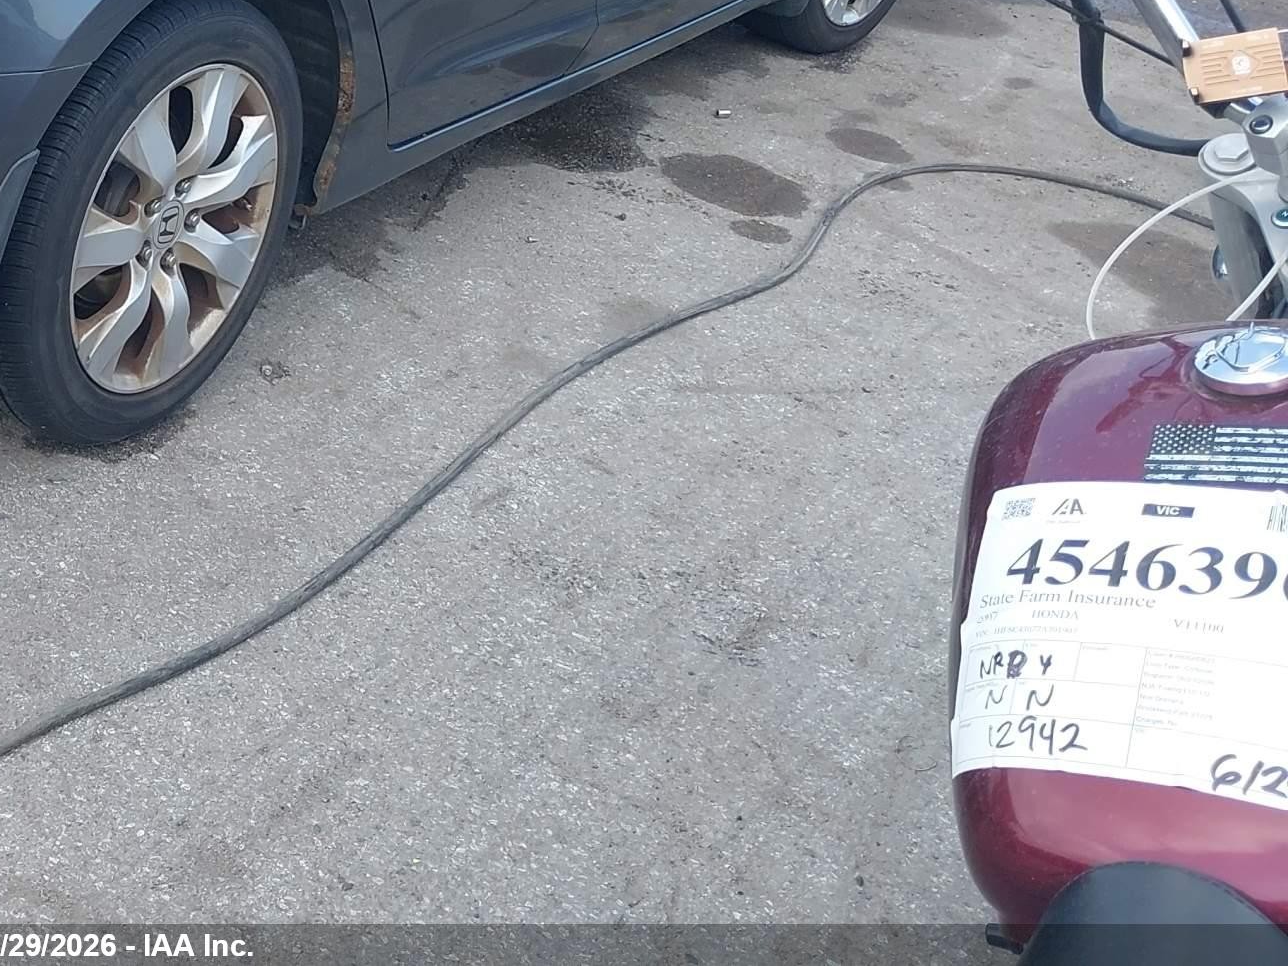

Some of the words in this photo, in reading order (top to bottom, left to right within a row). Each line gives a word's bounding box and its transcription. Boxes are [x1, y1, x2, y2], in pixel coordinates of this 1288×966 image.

[1155, 505, 1180, 516] VIC
[1006, 538, 1288, 600] 454639
[979, 592, 1015, 609] State
[1018, 588, 1061, 604] Farm
[1067, 591, 1156, 609] Insurance
[1031, 609, 1080, 621] HONDA
[1025, 683, 1054, 711] N
[988, 714, 1088, 756] 12942
